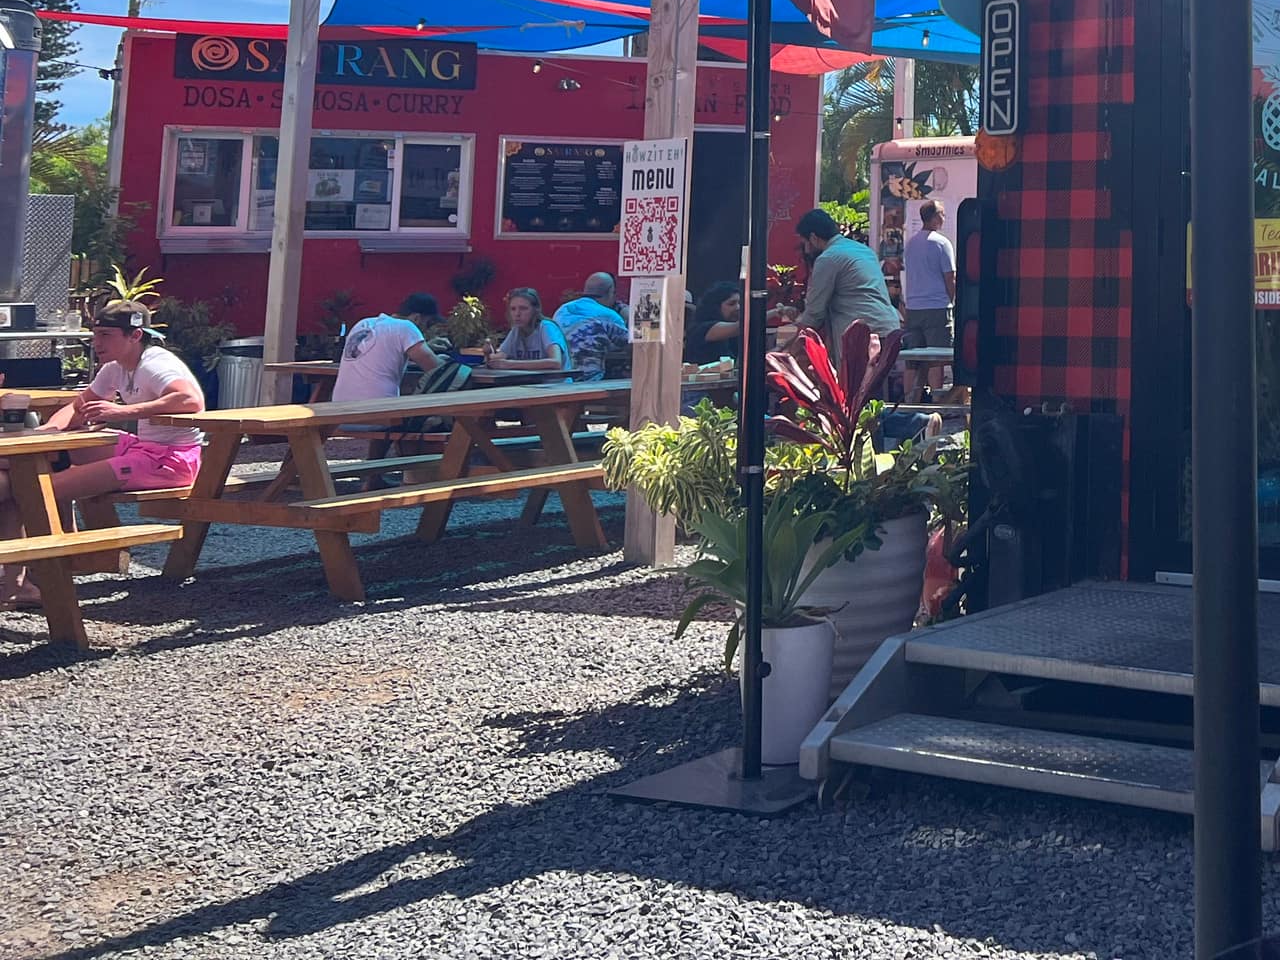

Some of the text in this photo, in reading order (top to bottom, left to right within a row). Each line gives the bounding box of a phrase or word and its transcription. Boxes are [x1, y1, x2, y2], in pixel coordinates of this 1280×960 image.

[990, 8, 1013, 129] OPEN
[183, 85, 465, 115] DOSA SOSA CURRY
[632, 167, 675, 191] menu
